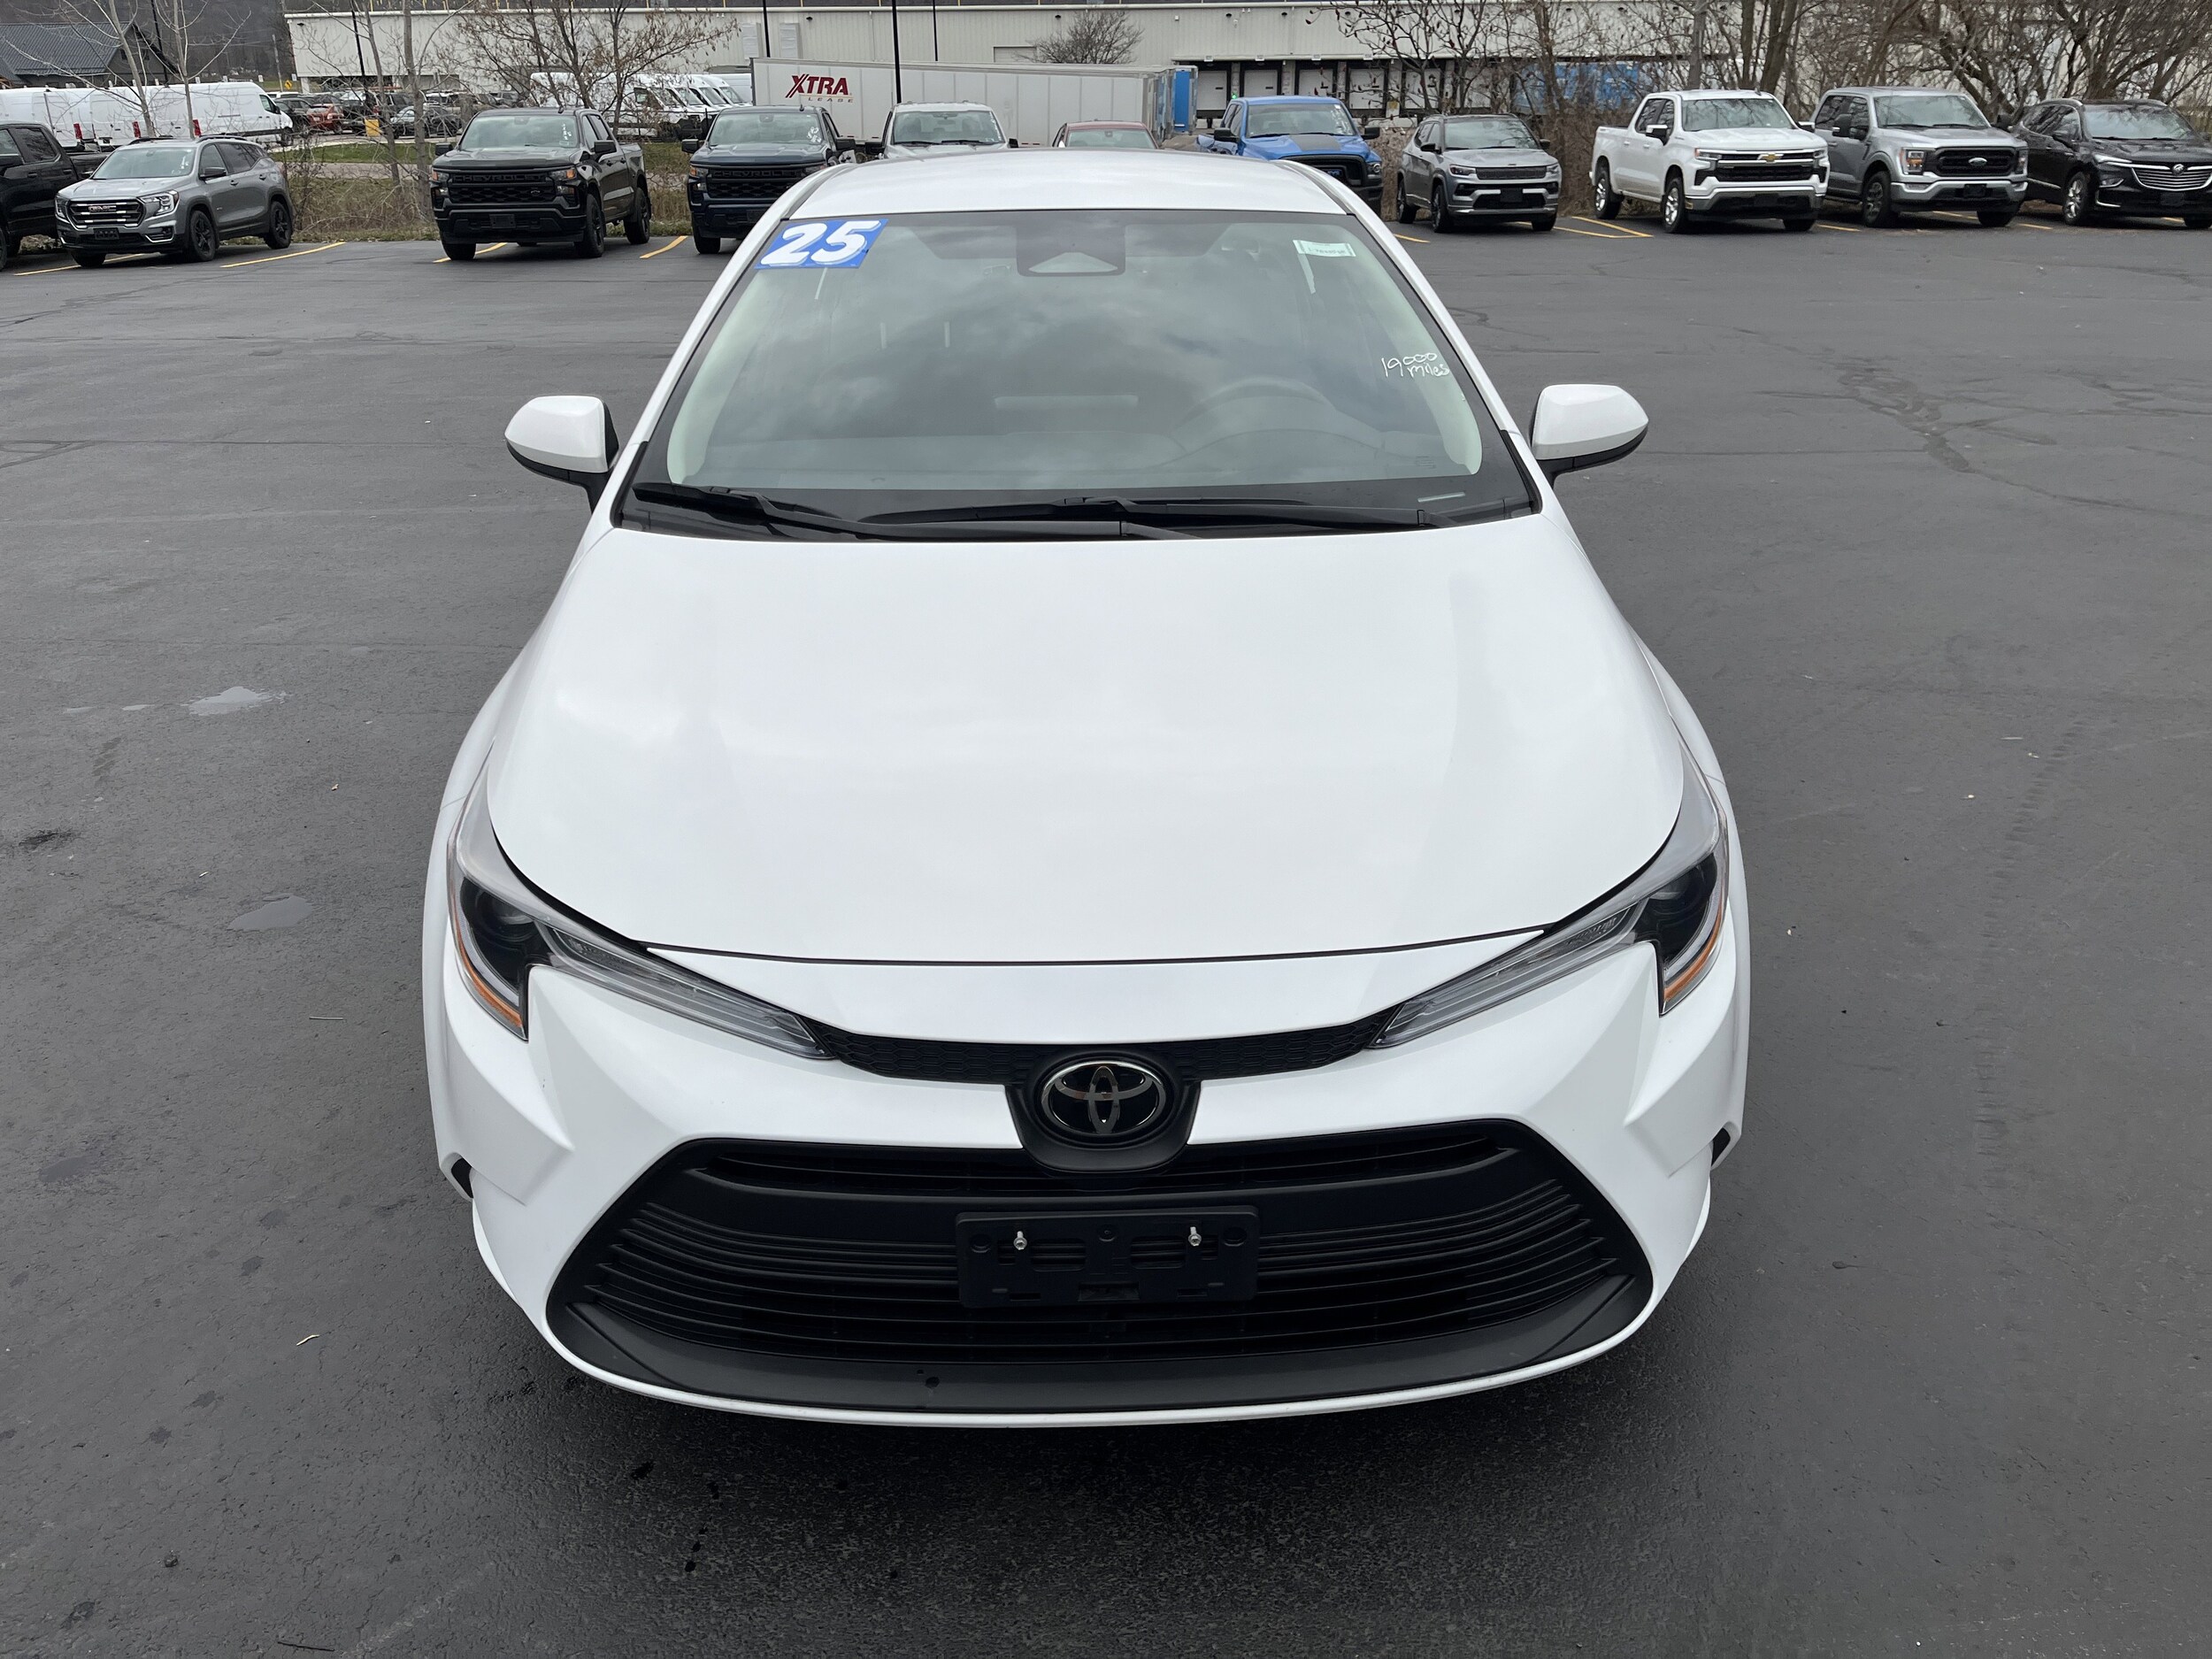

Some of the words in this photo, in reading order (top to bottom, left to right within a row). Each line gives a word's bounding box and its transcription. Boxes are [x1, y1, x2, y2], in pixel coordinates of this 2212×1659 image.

[785, 73, 849, 98] XTRA
[452, 173, 543, 182] CHEVROLET
[760, 220, 881, 266] 25
[1381, 352, 1438, 378] 19000
